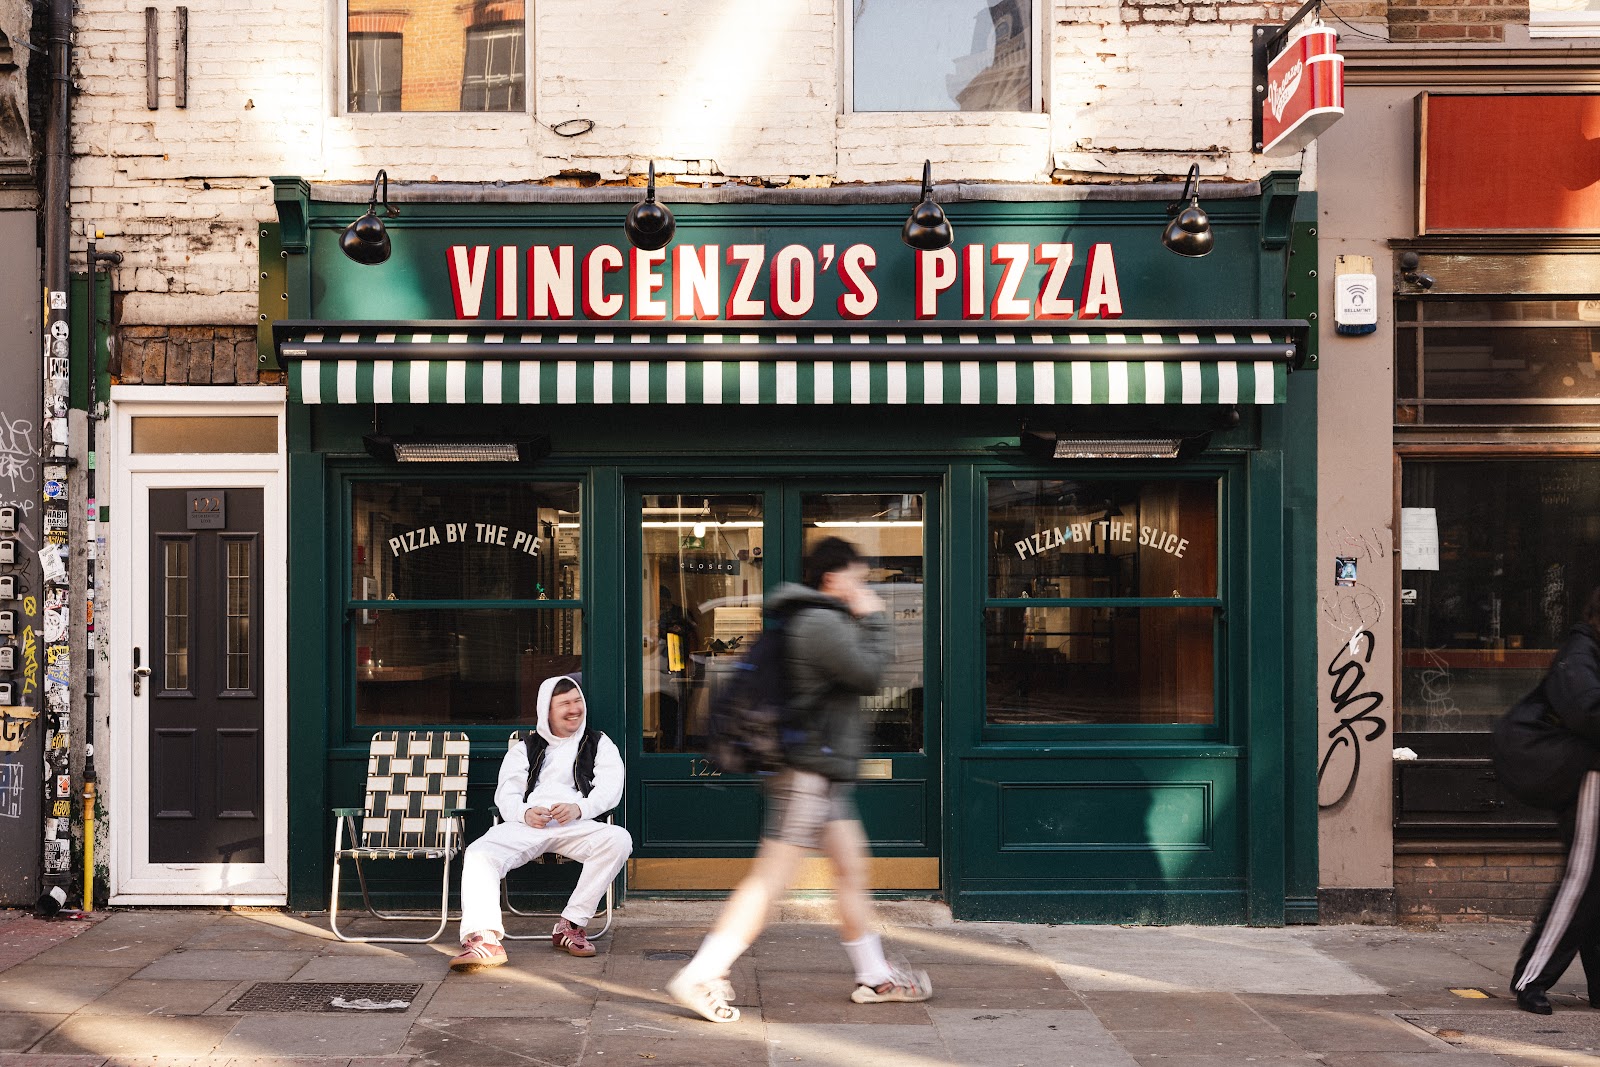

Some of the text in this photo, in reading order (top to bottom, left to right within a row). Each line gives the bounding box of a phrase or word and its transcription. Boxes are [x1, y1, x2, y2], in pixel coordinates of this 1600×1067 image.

[446, 242, 1124, 320] VINCENZO'S PIZZA
[192, 496, 221, 512] 122
[388, 526, 441, 558] PIZZA
[446, 522, 468, 543] BY
[474, 522, 509, 546] THE
[512, 530, 544, 557] PIE
[1014, 521, 1190, 560] PIZZA BY THE SLICE
[680, 562, 733, 570] CLOSED
[690, 758, 722, 777] 122
